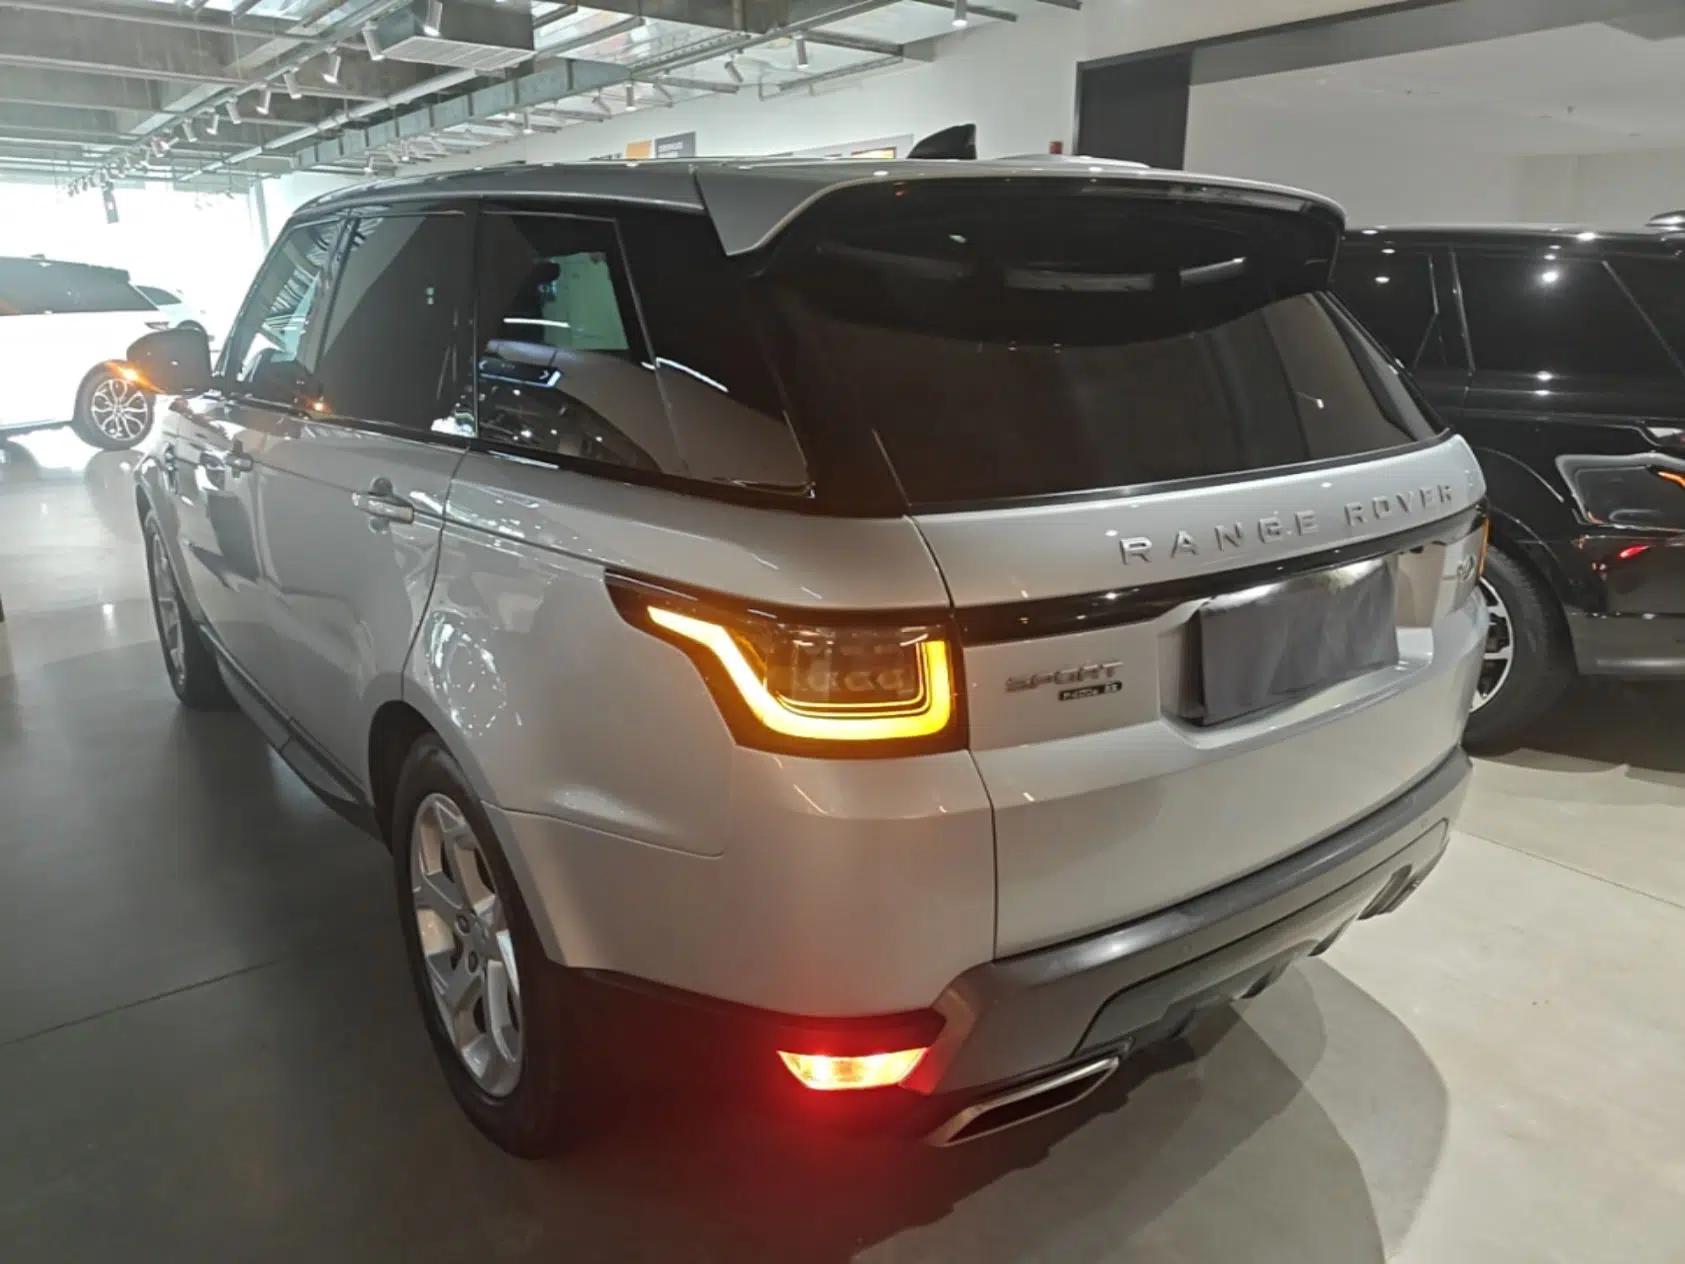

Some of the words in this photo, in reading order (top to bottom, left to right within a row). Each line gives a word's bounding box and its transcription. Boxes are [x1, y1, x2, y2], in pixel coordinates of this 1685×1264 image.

[1120, 511, 1318, 565] RANGE
[1344, 484, 1453, 527] ROVER
[1005, 661, 1123, 692] SPORT
